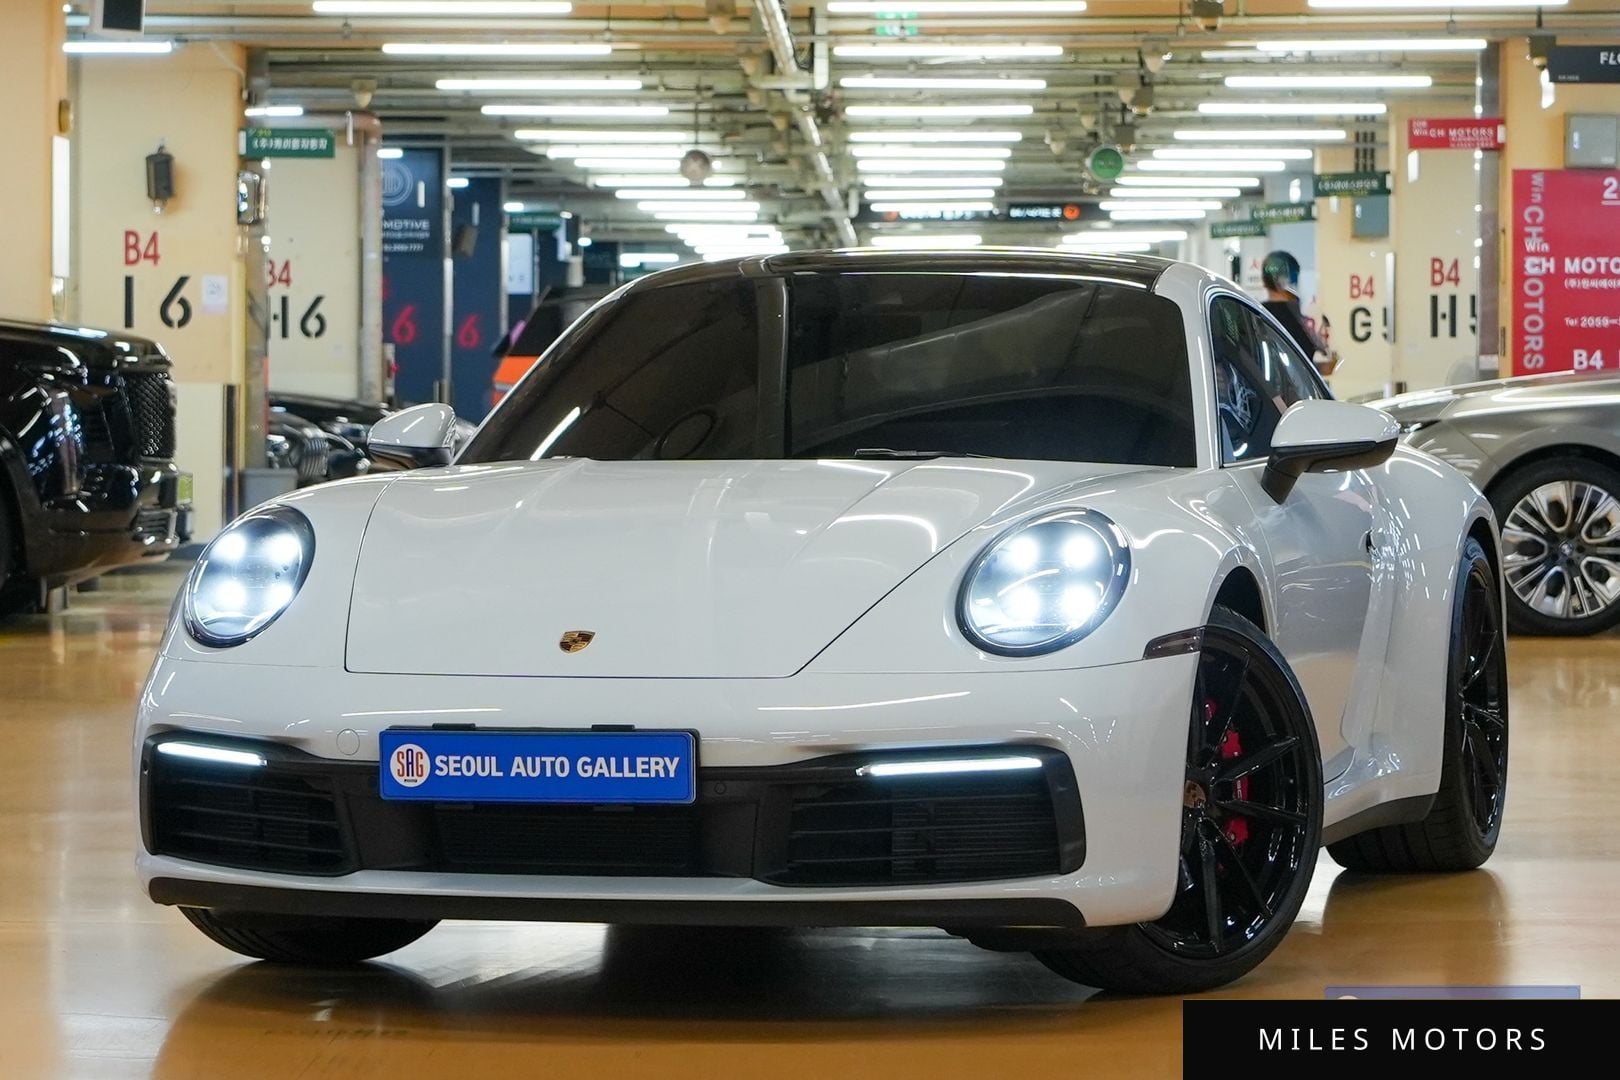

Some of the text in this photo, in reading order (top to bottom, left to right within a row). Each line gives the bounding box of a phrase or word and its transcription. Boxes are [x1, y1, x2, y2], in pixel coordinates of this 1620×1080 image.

[1448, 127, 1494, 137] MOTORS
[124, 230, 161, 267] B4
[1430, 257, 1461, 287] B4
[1350, 274, 1375, 299] B4
[1573, 349, 1604, 370] B4
[396, 748, 680, 778] SAG SEOUL AUTO GALLERY
